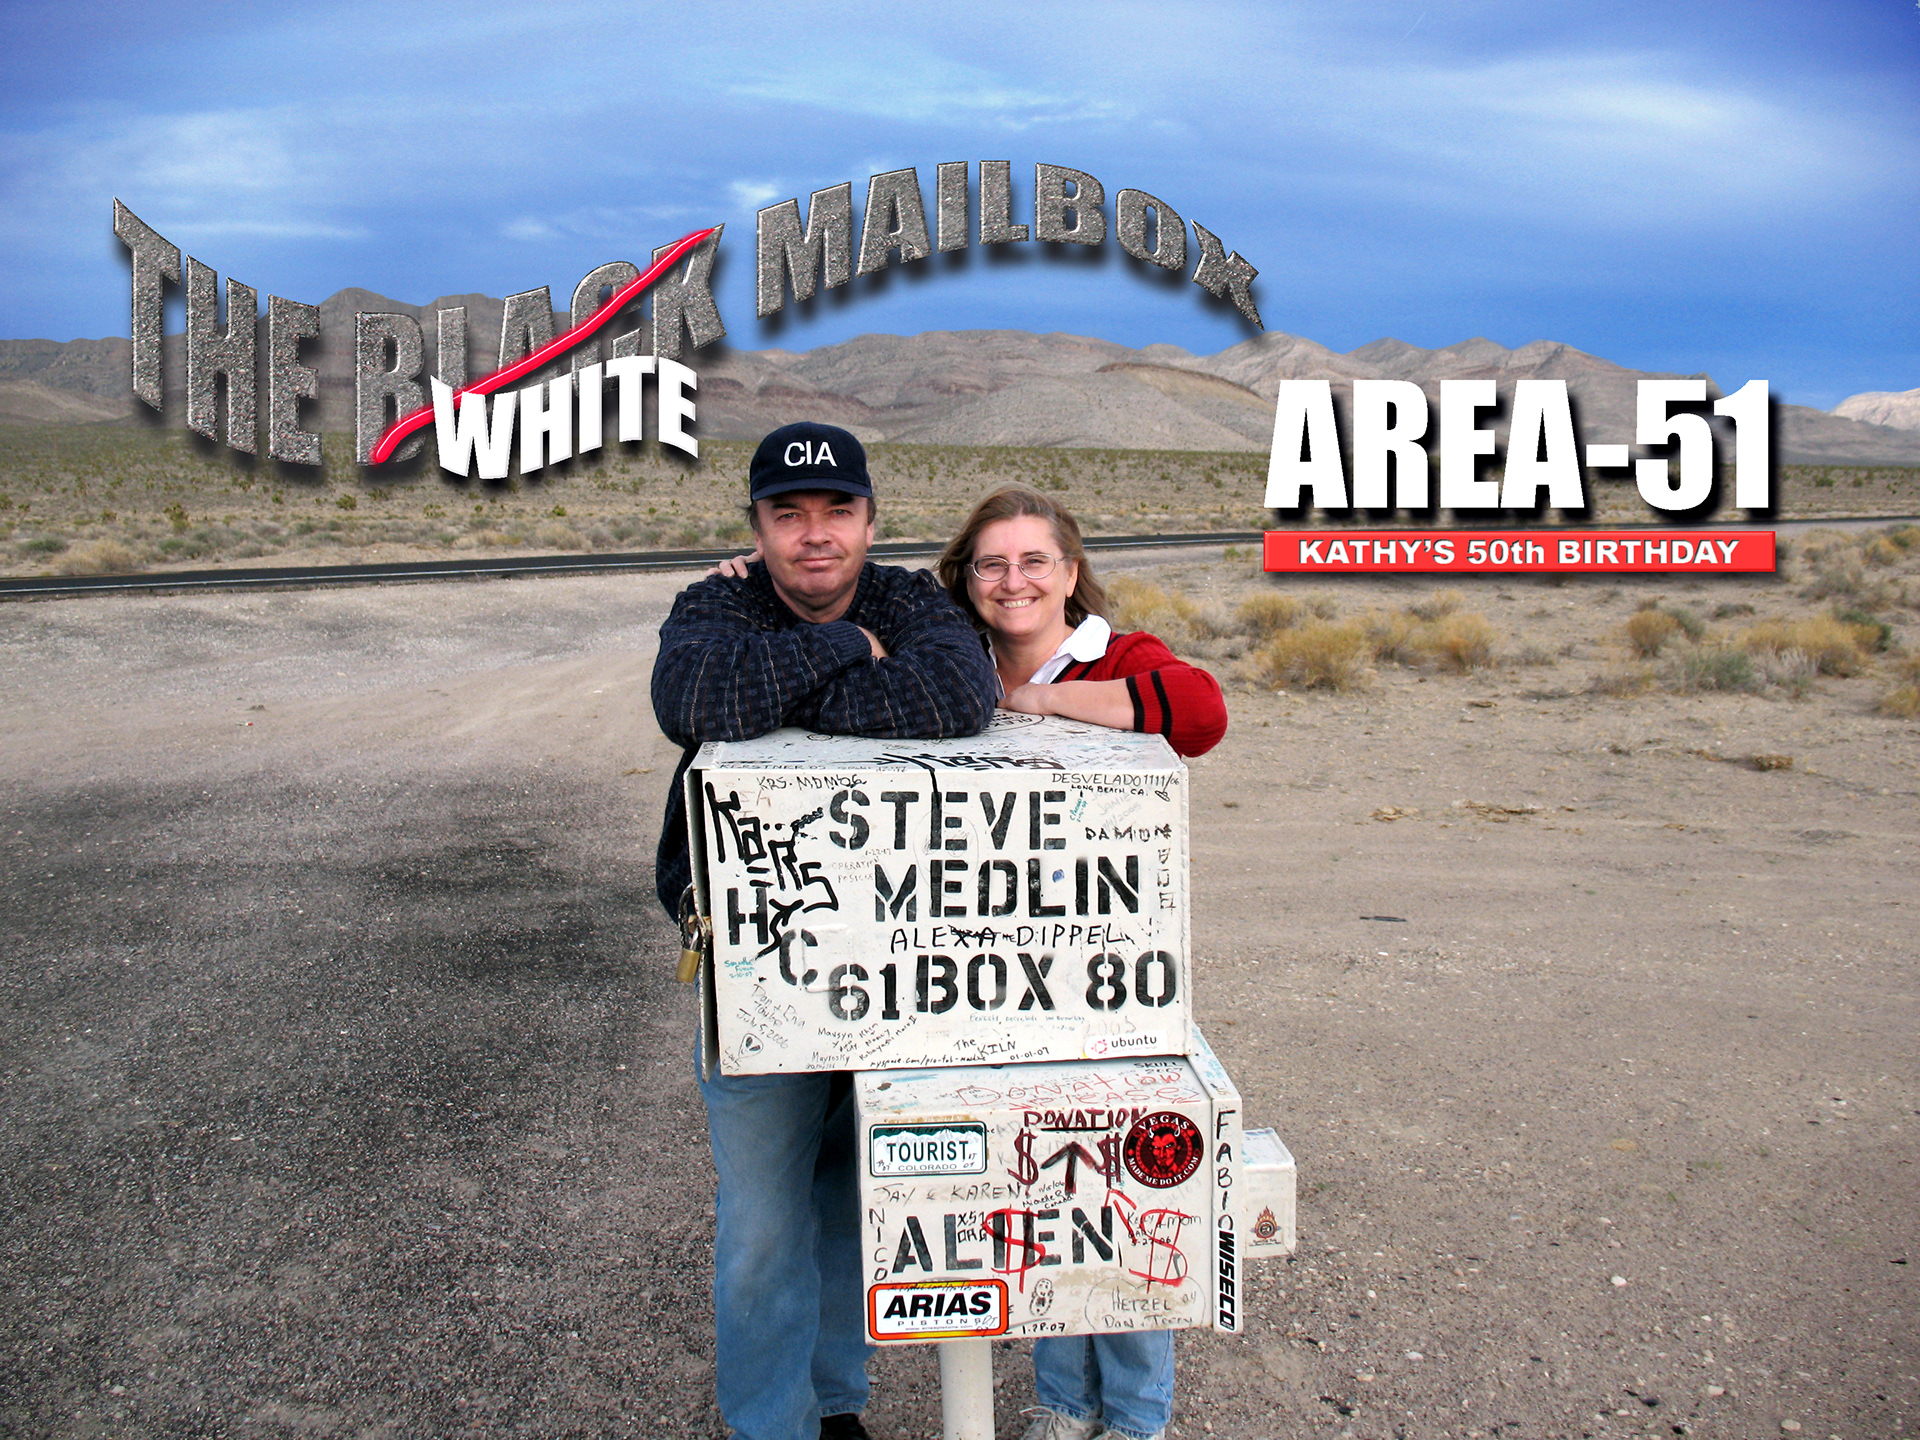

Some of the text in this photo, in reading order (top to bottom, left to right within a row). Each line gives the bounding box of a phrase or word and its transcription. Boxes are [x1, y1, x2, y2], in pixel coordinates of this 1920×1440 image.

[783, 440, 838, 467] CIA
[1097, 785, 1125, 794] BEACH
[829, 789, 1066, 851] STEVE
[875, 855, 1139, 922] MEDLIN
[829, 963, 900, 1021] 61
[916, 952, 1057, 1015] BOX
[1086, 950, 1177, 1012] 80
[1111, 1034, 1157, 1048] ubuntu
[1138, 1114, 1190, 1131] VEGAS
[886, 1140, 969, 1163] TOURIST
[898, 1163, 958, 1171] COLORADO
[1127, 1157, 1146, 1179] MADE
[1145, 1175, 1158, 1185] ME
[1160, 1177, 1173, 1186] DO
[892, 1206, 1114, 1274] ALIEN
[1218, 1230, 1236, 1331] WISECO
[883, 1291, 992, 1320] ARIAS
[897, 1317, 982, 1327] PISTONS
